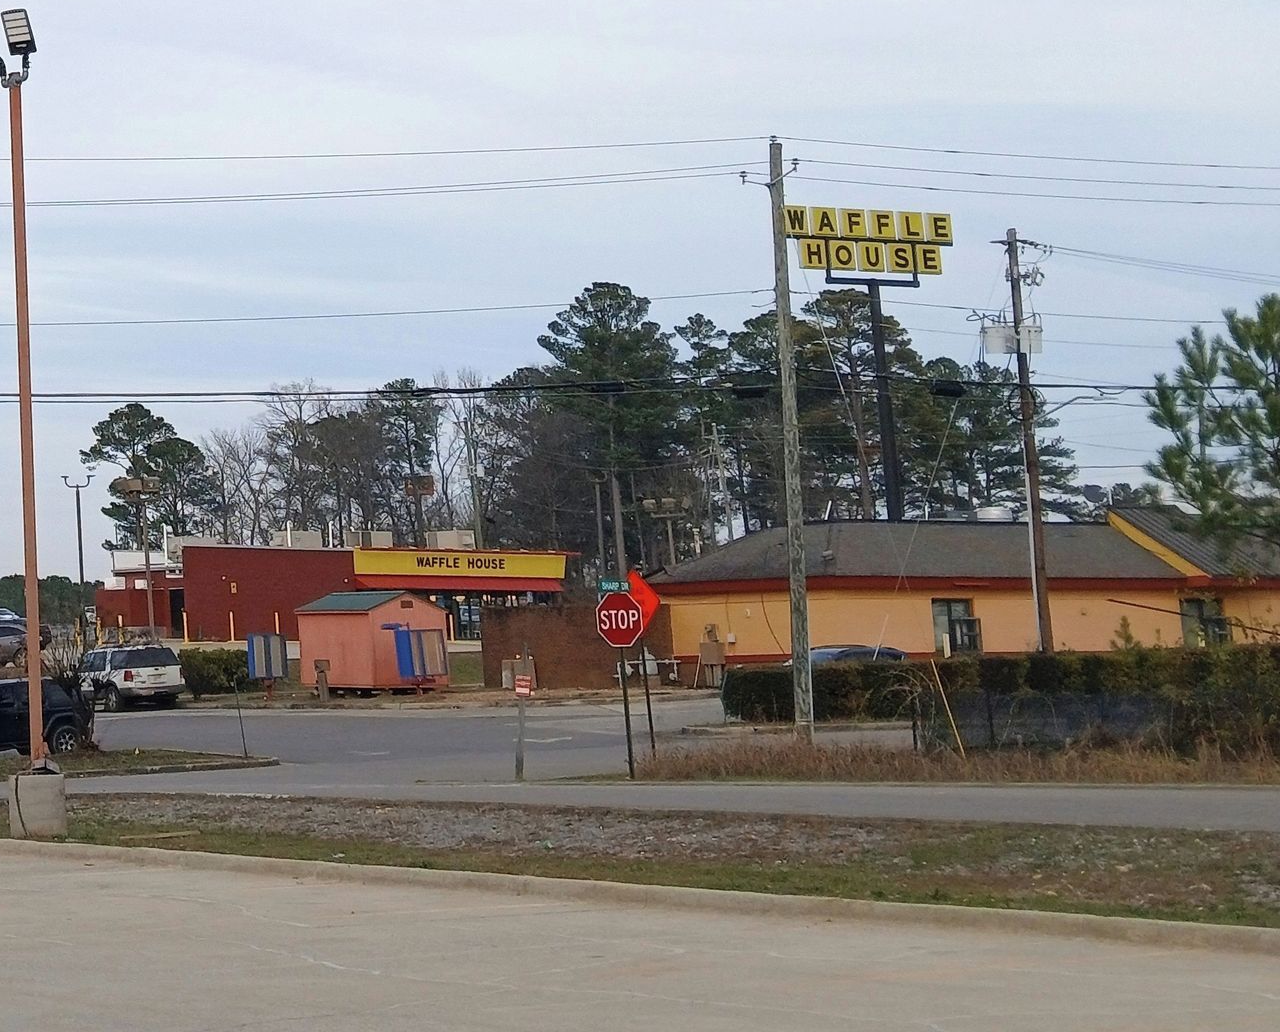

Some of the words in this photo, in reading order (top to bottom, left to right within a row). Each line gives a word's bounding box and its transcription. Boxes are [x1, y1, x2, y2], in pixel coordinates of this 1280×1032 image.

[786, 209, 949, 238] WAFFLE
[806, 242, 938, 270] HOUSE
[416, 556, 460, 569] WAFFLE
[467, 557, 506, 569] HOUSE
[600, 609, 639, 630] STOP
